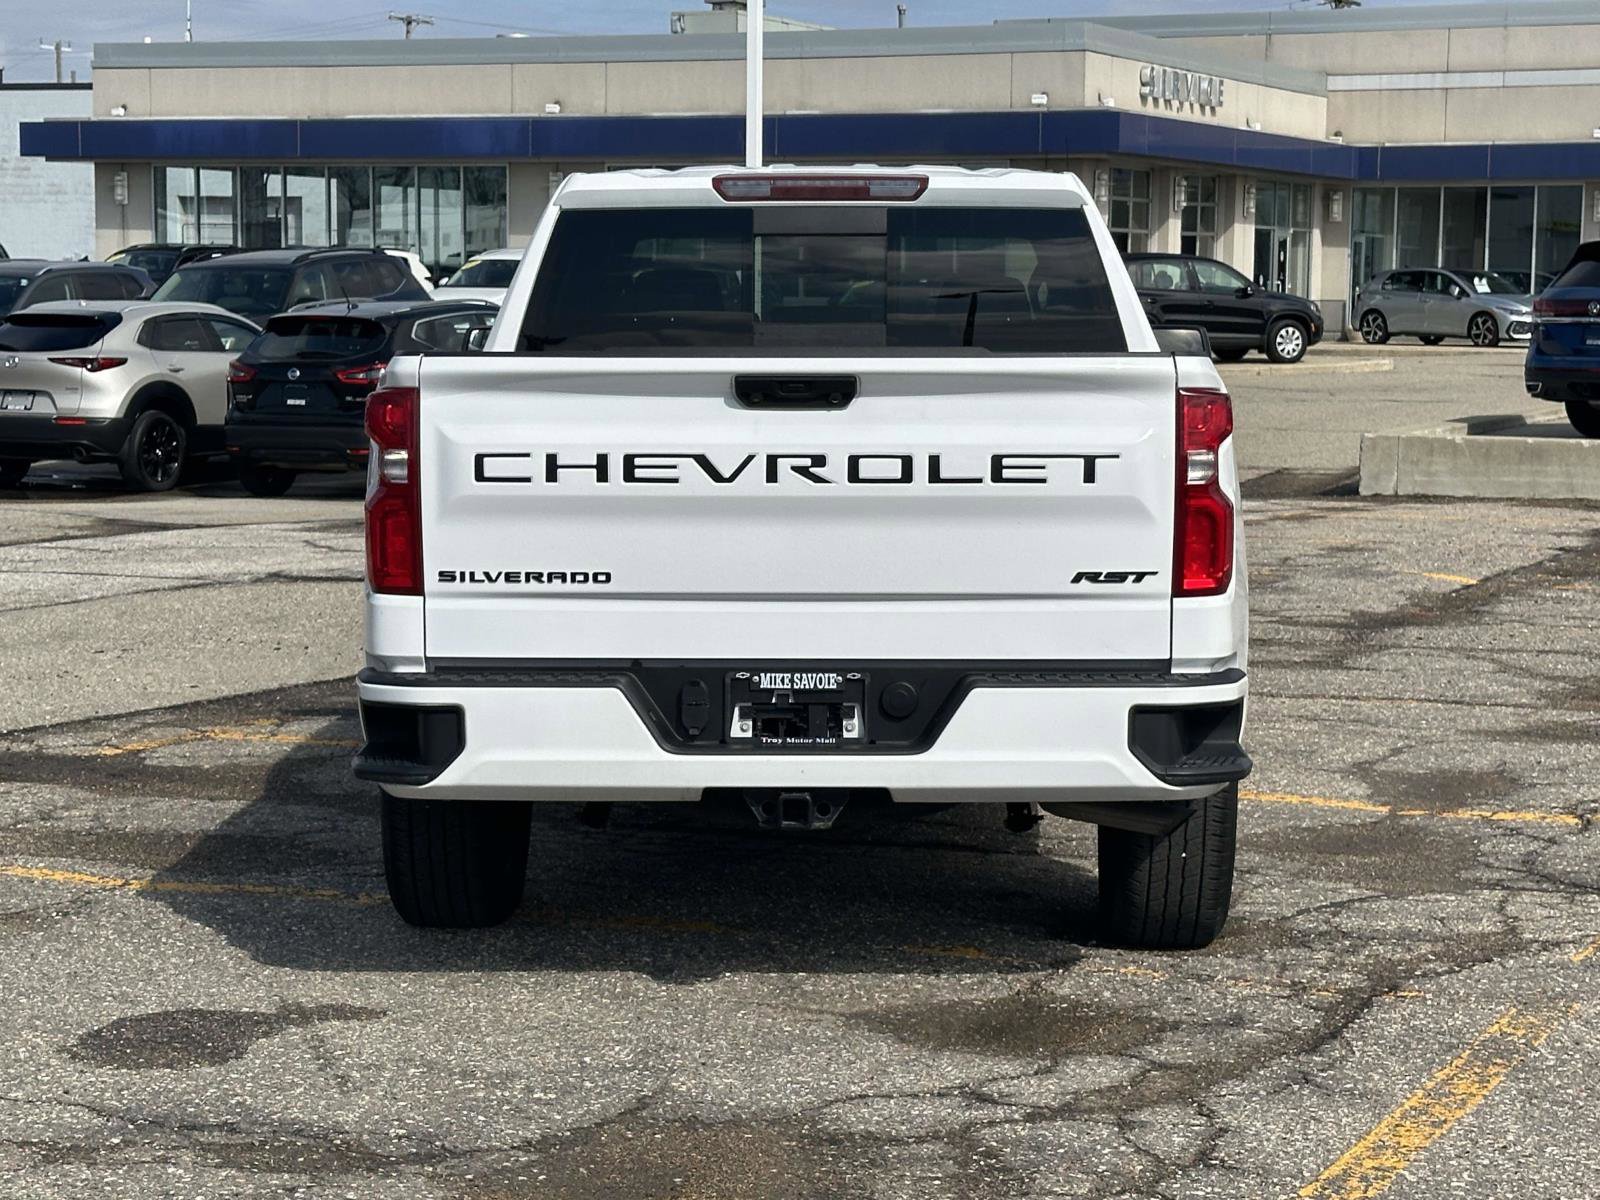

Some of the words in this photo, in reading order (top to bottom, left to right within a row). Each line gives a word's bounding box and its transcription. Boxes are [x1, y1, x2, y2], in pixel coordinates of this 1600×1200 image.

[475, 453, 1119, 483] CHEVROLET
[438, 571, 612, 584] SILVERADO
[1071, 571, 1158, 584] RST
[760, 673, 791, 689] MIKE
[793, 673, 837, 689] SAVOIE
[760, 737, 783, 745] Troy
